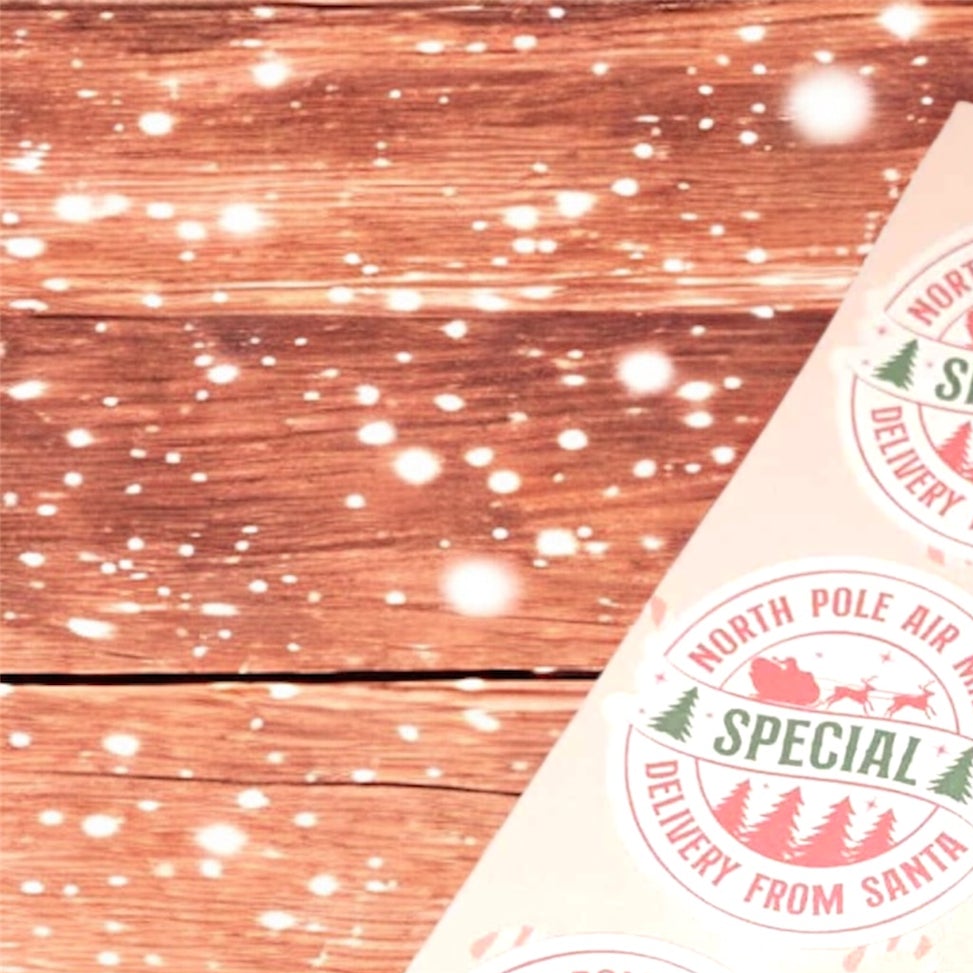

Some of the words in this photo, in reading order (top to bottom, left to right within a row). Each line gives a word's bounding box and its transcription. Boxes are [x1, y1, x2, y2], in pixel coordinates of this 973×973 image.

[871, 406, 966, 517] DELIVERY
[687, 596, 794, 673] NORTH
[811, 587, 894, 622] POLE
[901, 604, 961, 654] AIR
[714, 709, 922, 786] SPECIAL
[645, 760, 741, 887] DELIVERY
[744, 873, 844, 916] FROM
[861, 832, 968, 908] SANTA
